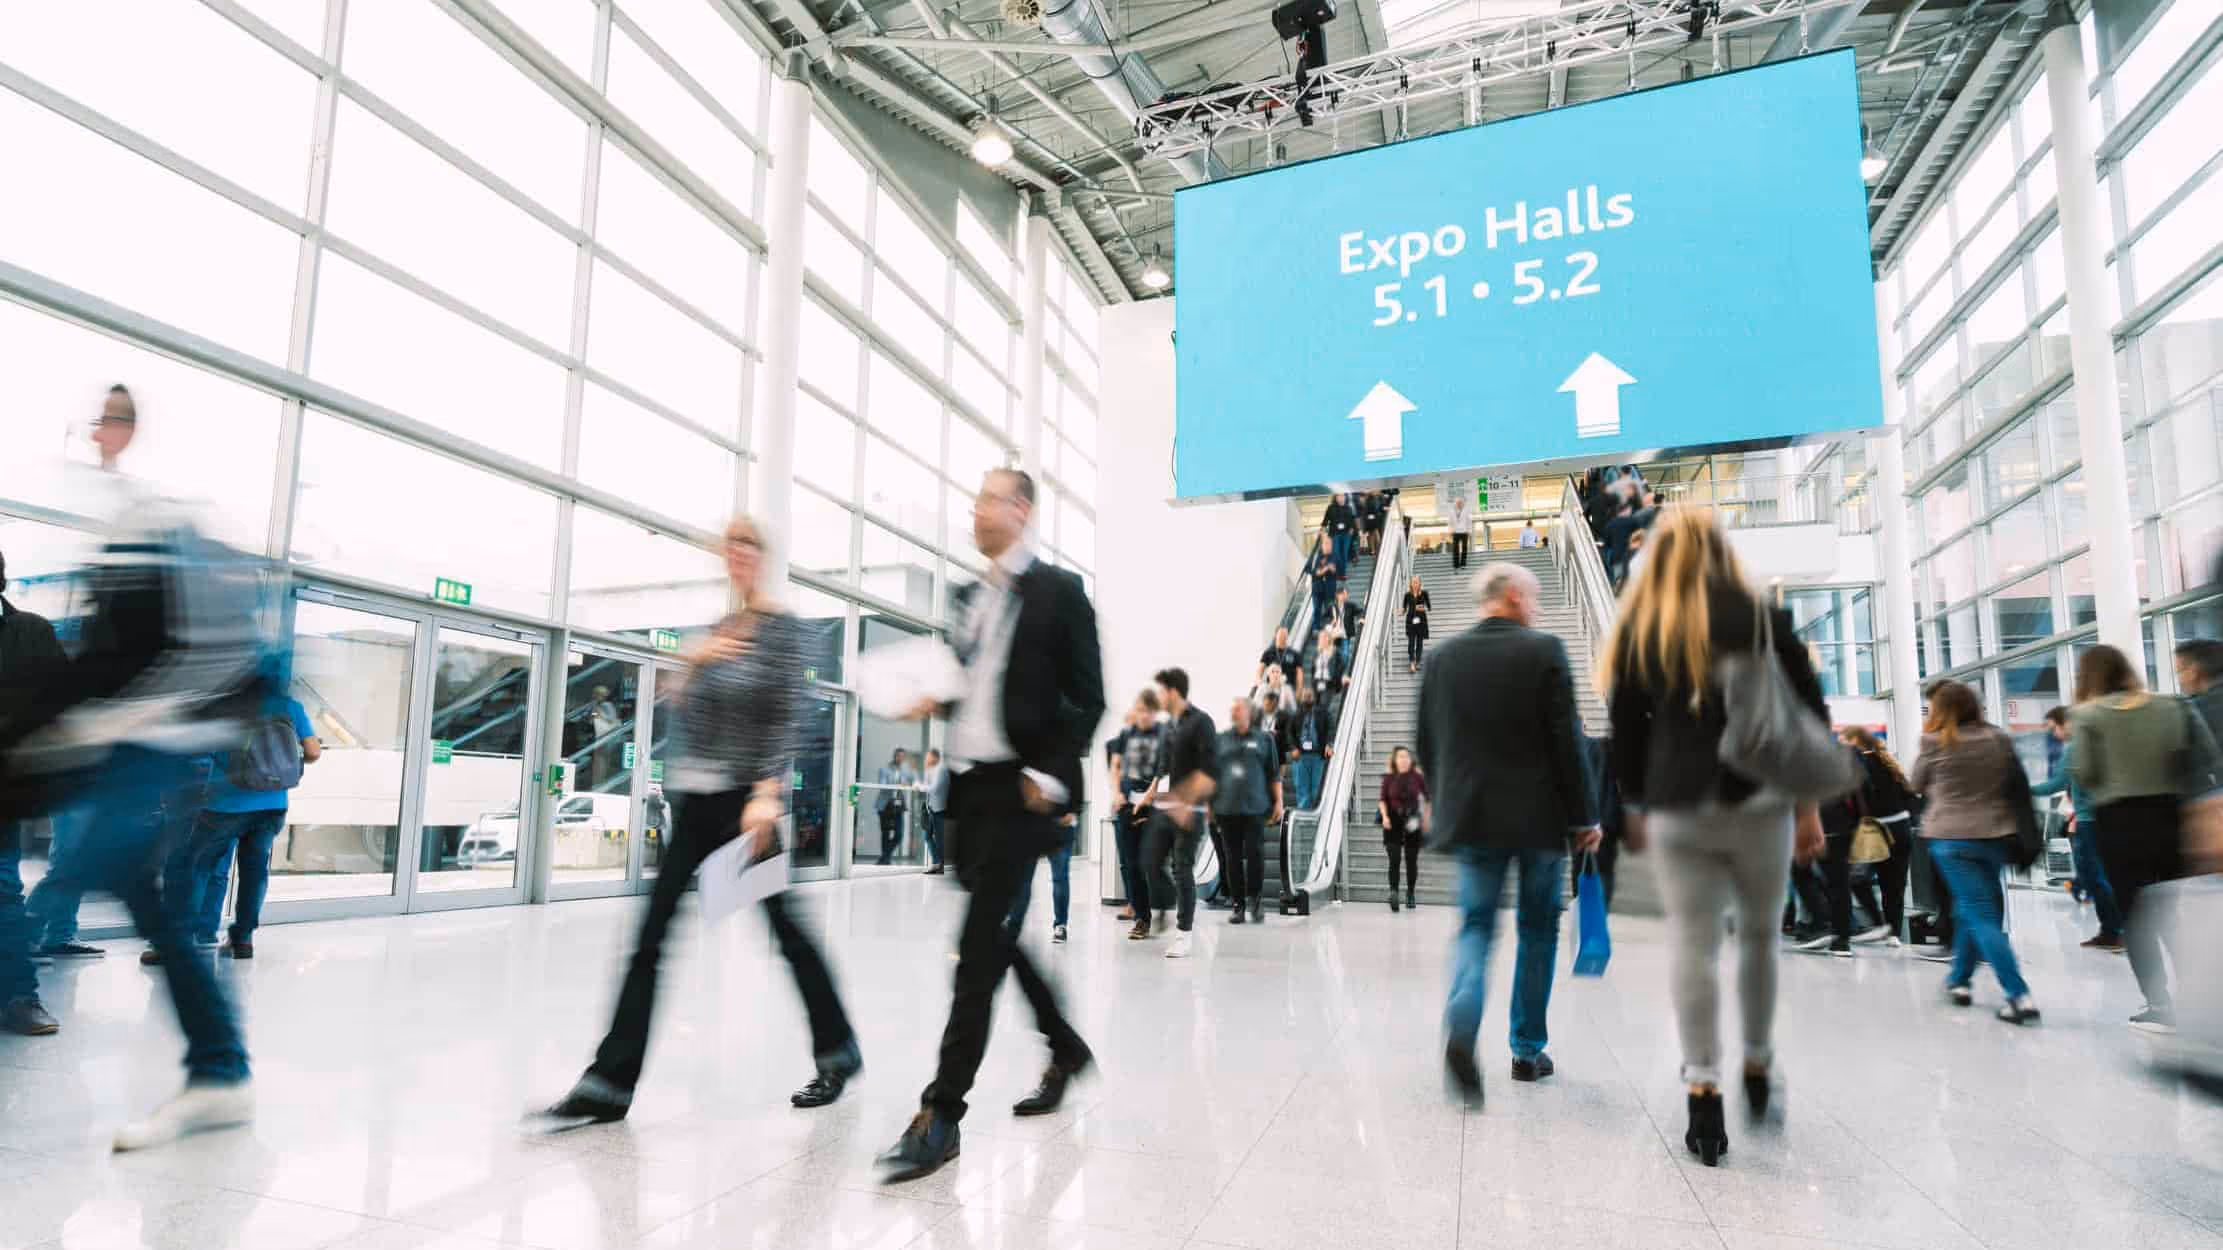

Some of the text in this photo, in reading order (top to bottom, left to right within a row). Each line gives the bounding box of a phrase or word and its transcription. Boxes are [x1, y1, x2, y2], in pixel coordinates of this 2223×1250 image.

[1338, 184, 1635, 278] Expo Halls
[1372, 273, 1448, 327] 5.1
[1512, 250, 1601, 305] 5.2
[1488, 481, 1500, 490] 10
